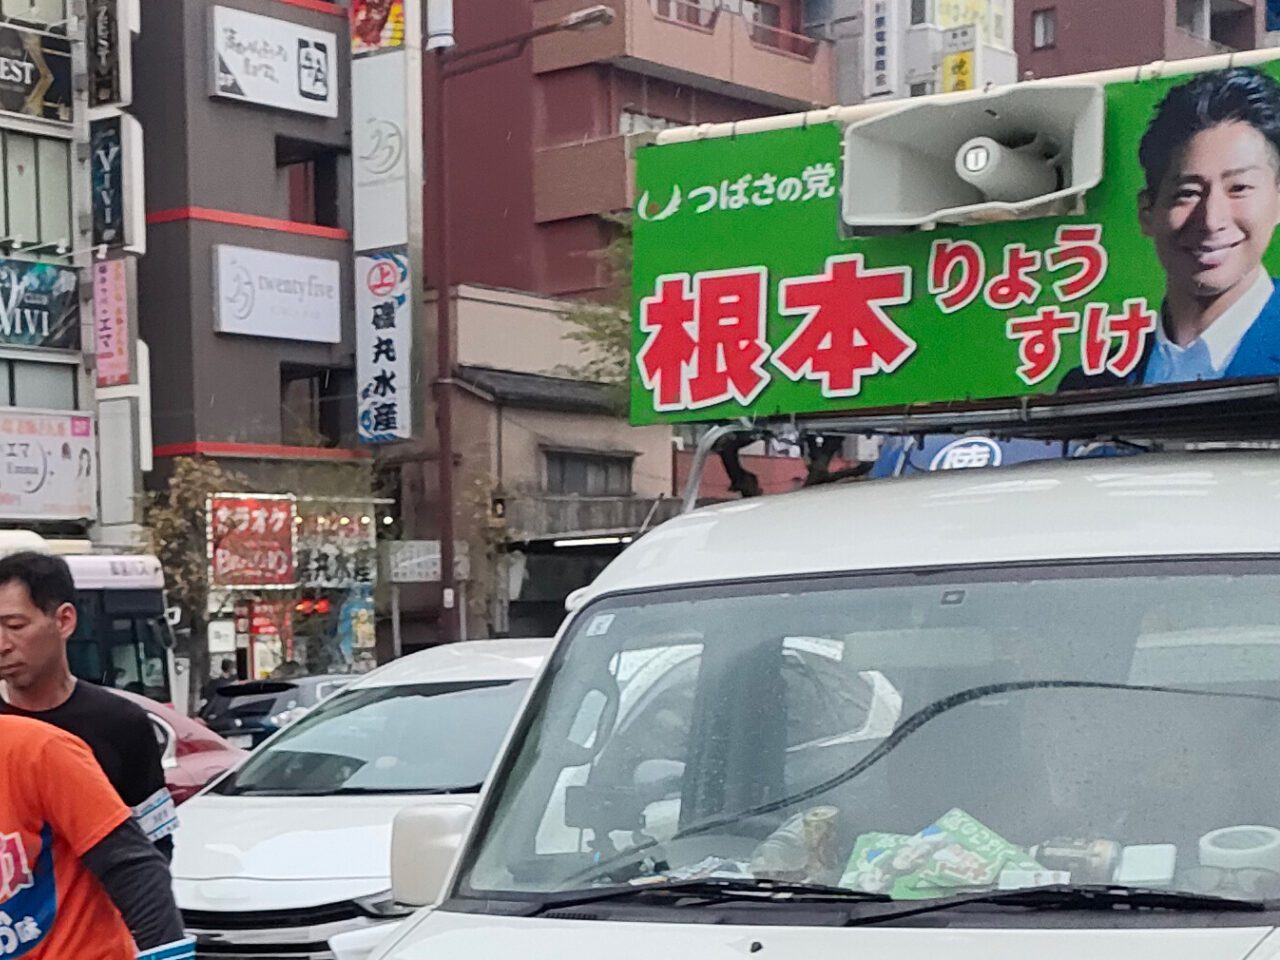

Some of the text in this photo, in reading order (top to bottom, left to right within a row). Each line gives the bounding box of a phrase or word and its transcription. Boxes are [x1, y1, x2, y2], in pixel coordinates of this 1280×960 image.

[97, 6, 110, 66] ZEST
[687, 162, 835, 214] つばさの党
[927, 224, 1108, 313] りょう
[371, 302, 399, 432] 磯丸水産
[636, 253, 917, 412] 根本
[1007, 298, 1157, 385] すけ
